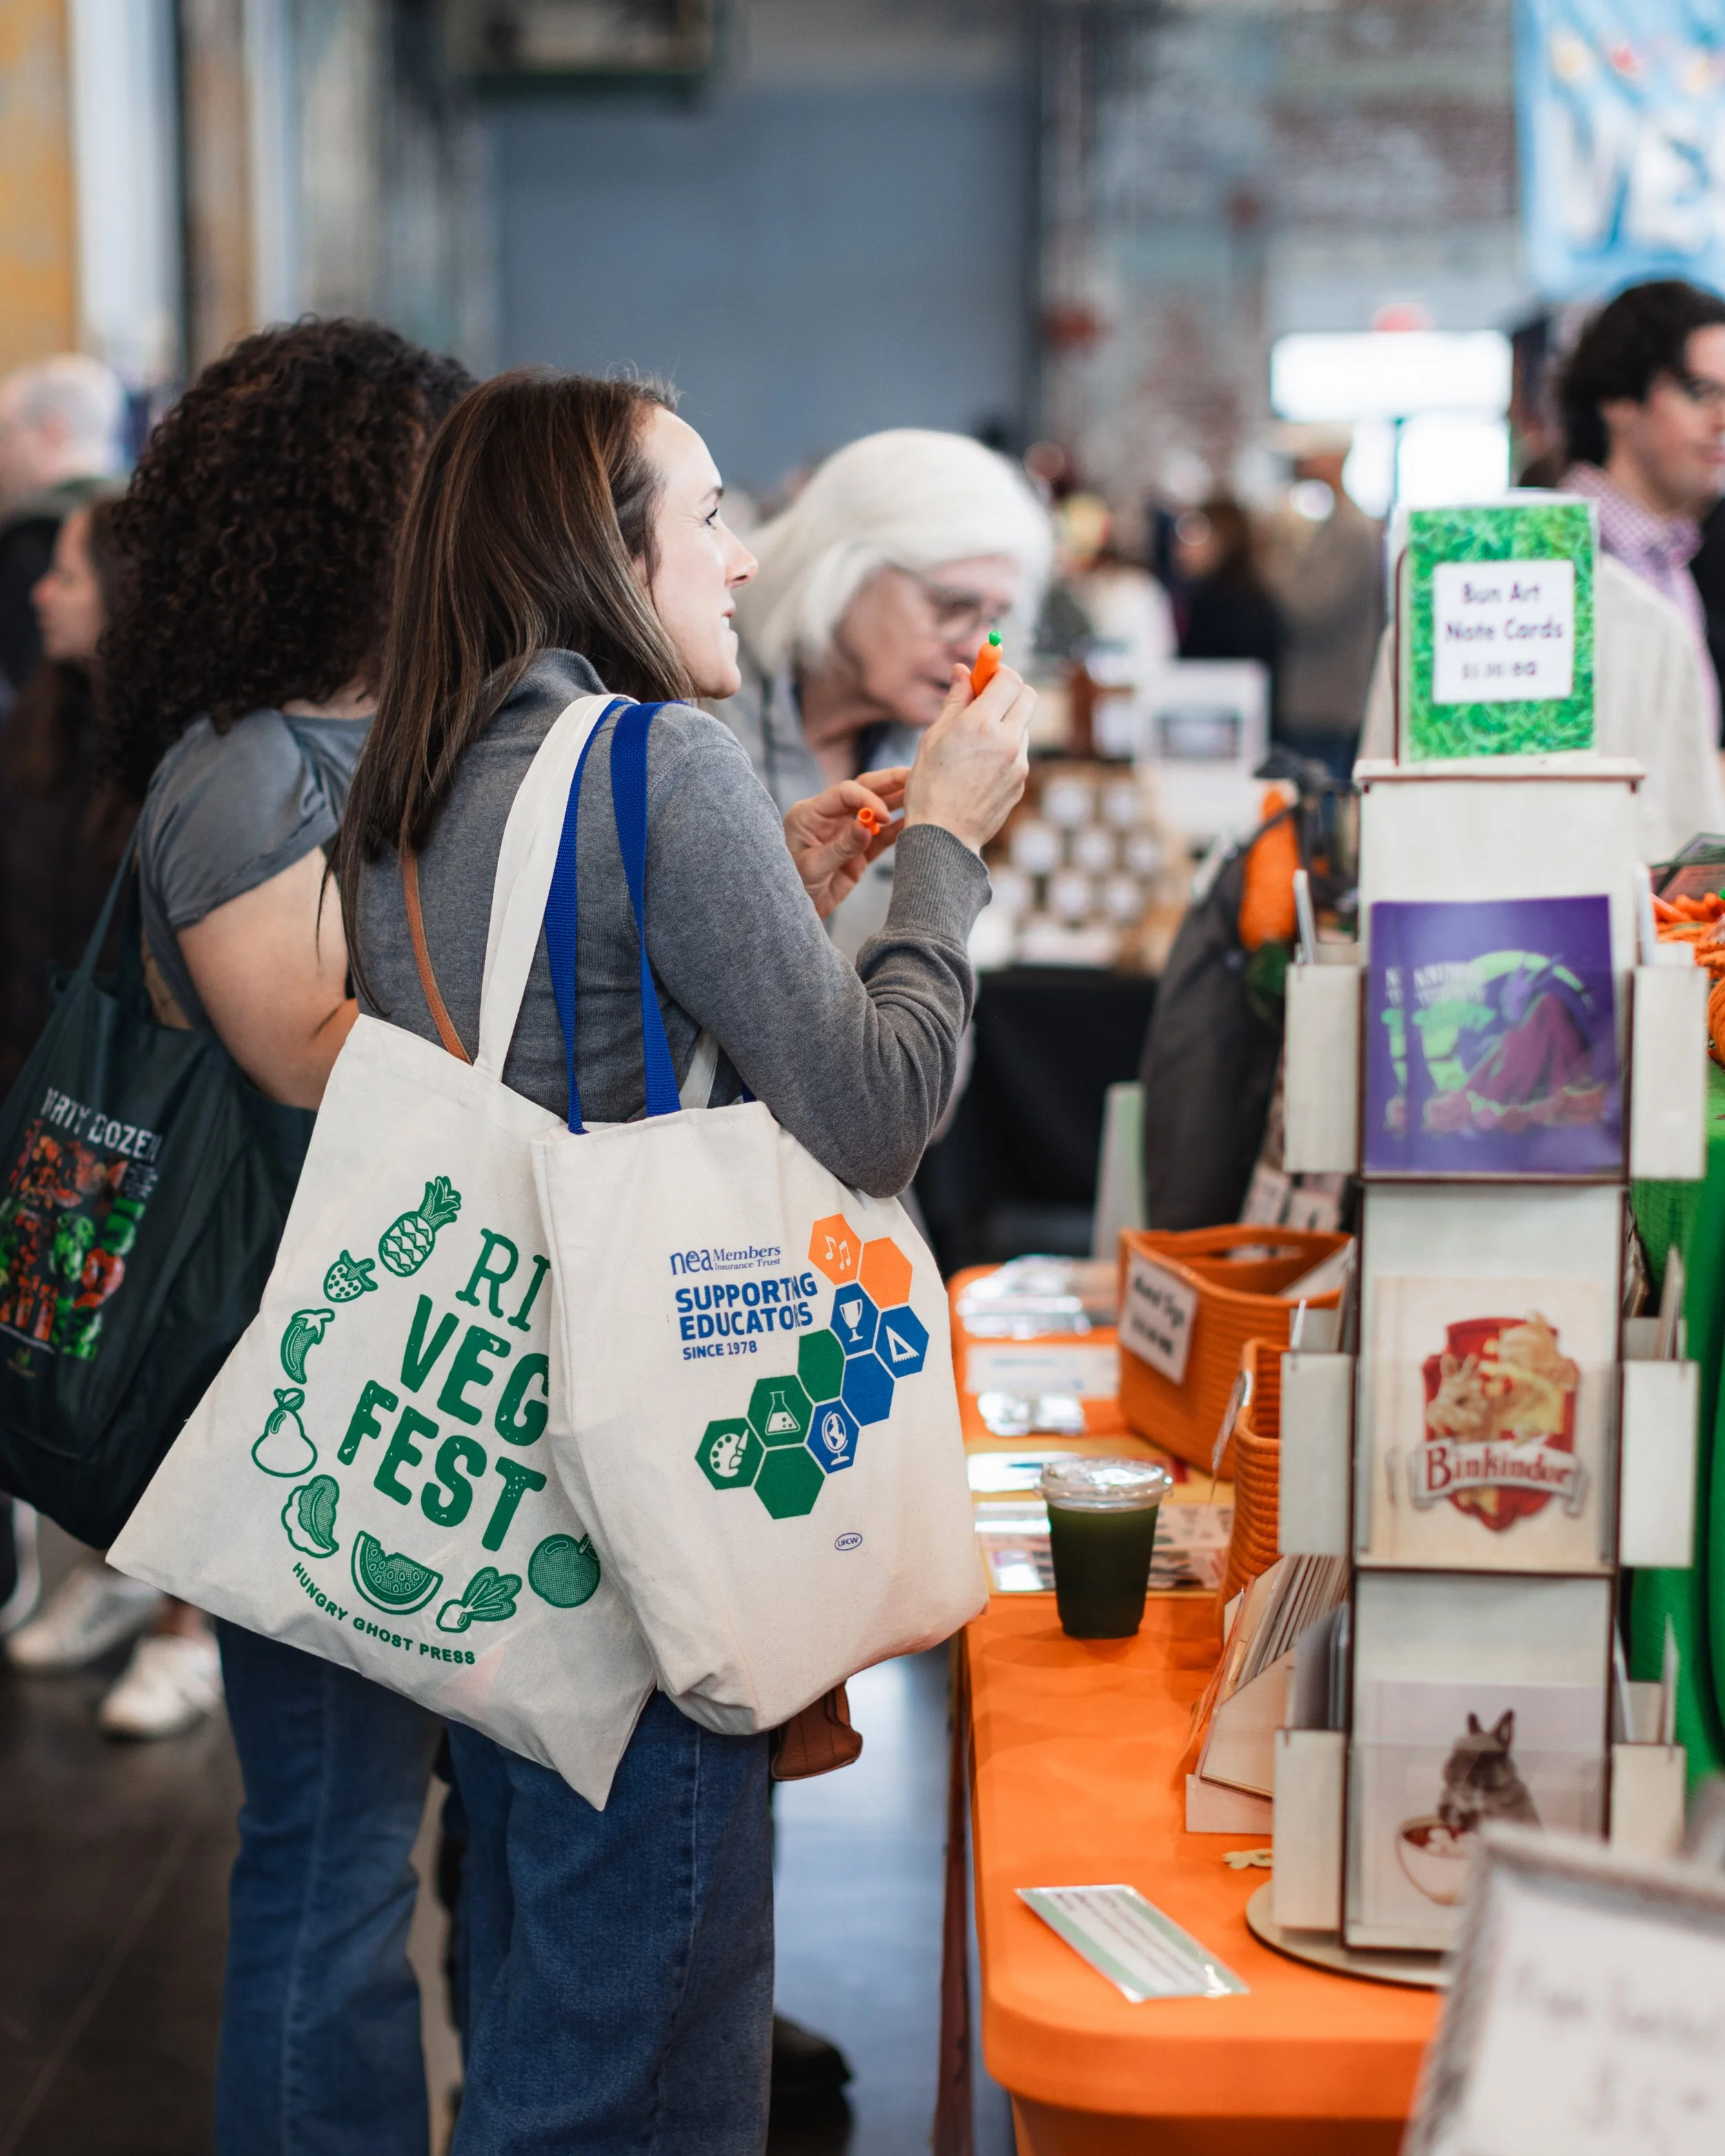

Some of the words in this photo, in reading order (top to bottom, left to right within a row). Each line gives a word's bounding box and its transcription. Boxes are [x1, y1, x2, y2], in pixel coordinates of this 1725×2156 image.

[455, 1227, 551, 1332] RI
[669, 1249, 713, 1276] nea
[713, 1245, 781, 1262] Members
[675, 1272, 818, 1314] SUPPORTNG
[715, 1262, 753, 1272] Insurance
[756, 1257, 780, 1268] Trust
[400, 1294, 549, 1447] VEG
[682, 1343, 724, 1361] SINCE
[727, 1340, 757, 1356] 1978
[337, 1379, 548, 1552] FEST
[292, 1561, 348, 1621] HUNGRY
[353, 1616, 414, 1651] GHOST
[420, 1643, 475, 1665] PRESS
